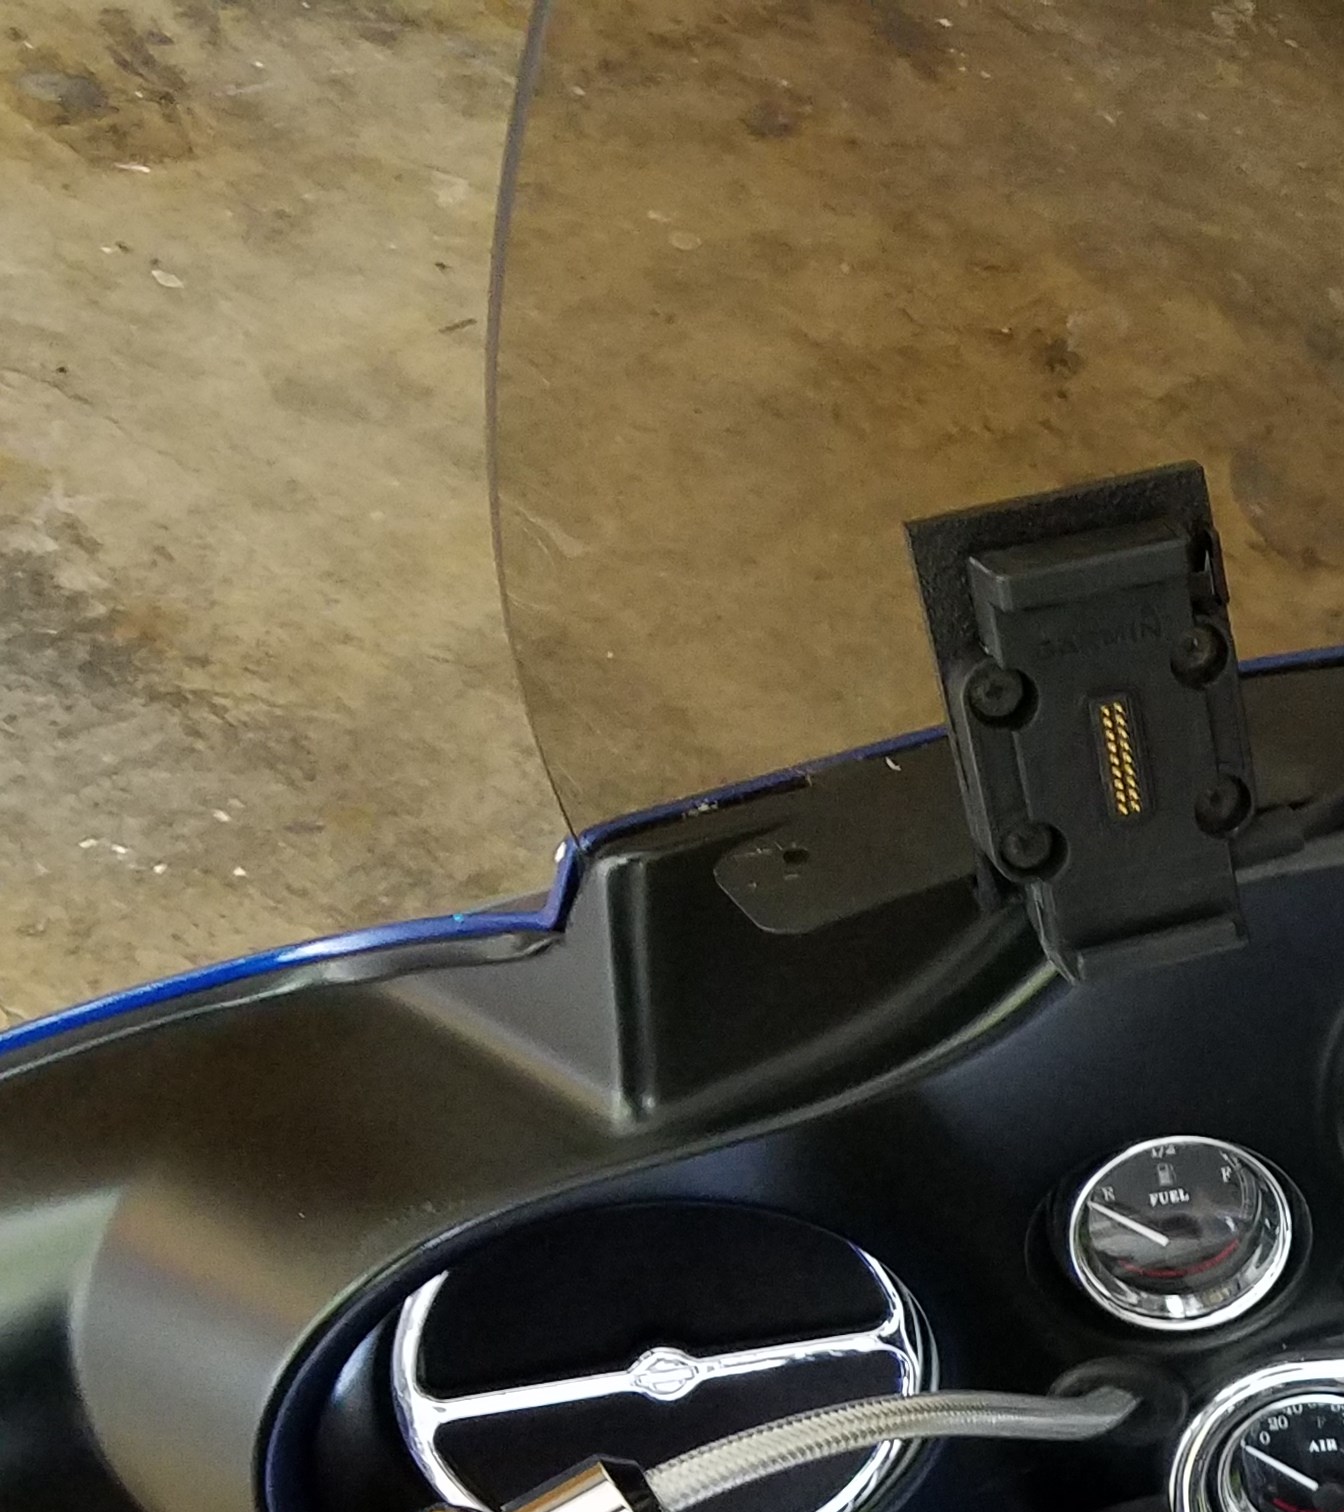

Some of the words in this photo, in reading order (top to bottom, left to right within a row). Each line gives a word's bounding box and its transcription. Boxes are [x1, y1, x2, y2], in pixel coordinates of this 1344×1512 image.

[1149, 1188, 1190, 1208] FUEL
[1259, 1430, 1271, 1446] 0
[1308, 1437, 1338, 1453] AIR
